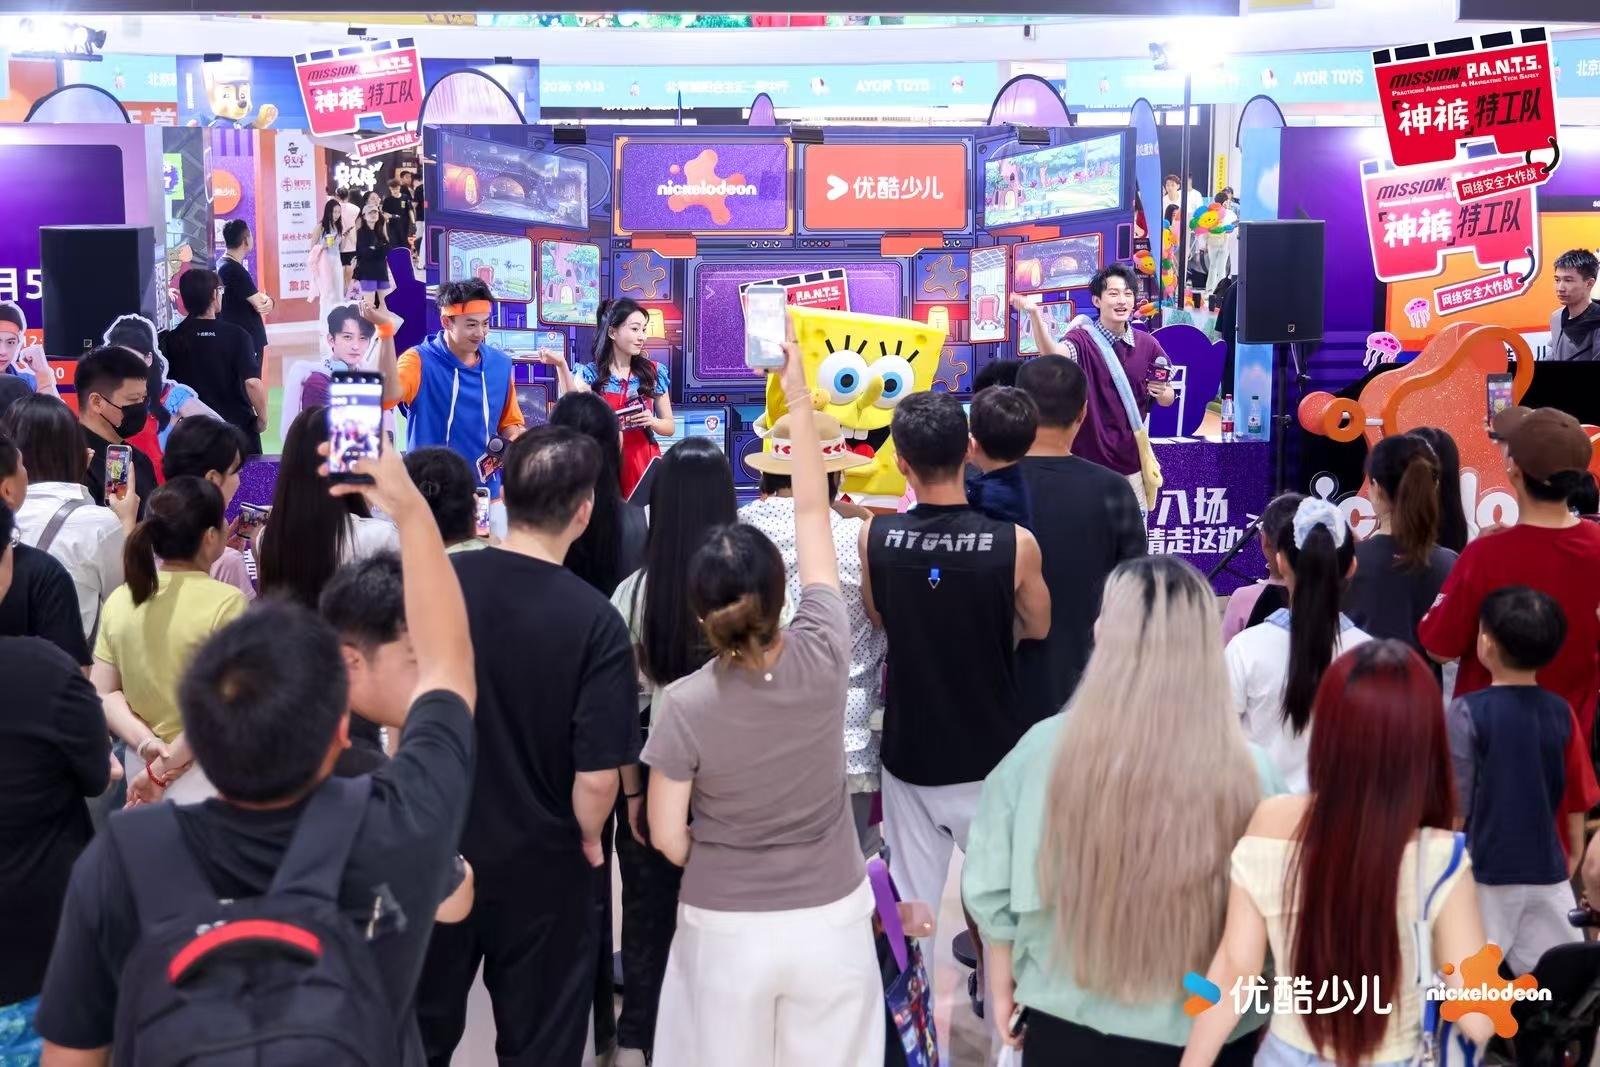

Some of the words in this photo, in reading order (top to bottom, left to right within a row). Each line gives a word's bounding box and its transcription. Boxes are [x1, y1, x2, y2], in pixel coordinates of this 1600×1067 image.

[1466, 55, 1542, 79] P.A.N.T.S.
[1576, 59, 1600, 77] 北京
[856, 78, 892, 93] AYOR
[896, 78, 931, 92] TOYS
[1293, 71, 1328, 86] AYOR
[1331, 69, 1364, 84] TOYS
[656, 179, 758, 196] nickelodeon
[852, 175, 944, 200] 优酷少儿
[1461, 167, 1539, 197] 网络安全大作战
[796, 285, 842, 302] P.A.N.T.S.
[1441, 276, 1514, 308] 网络安全大作战
